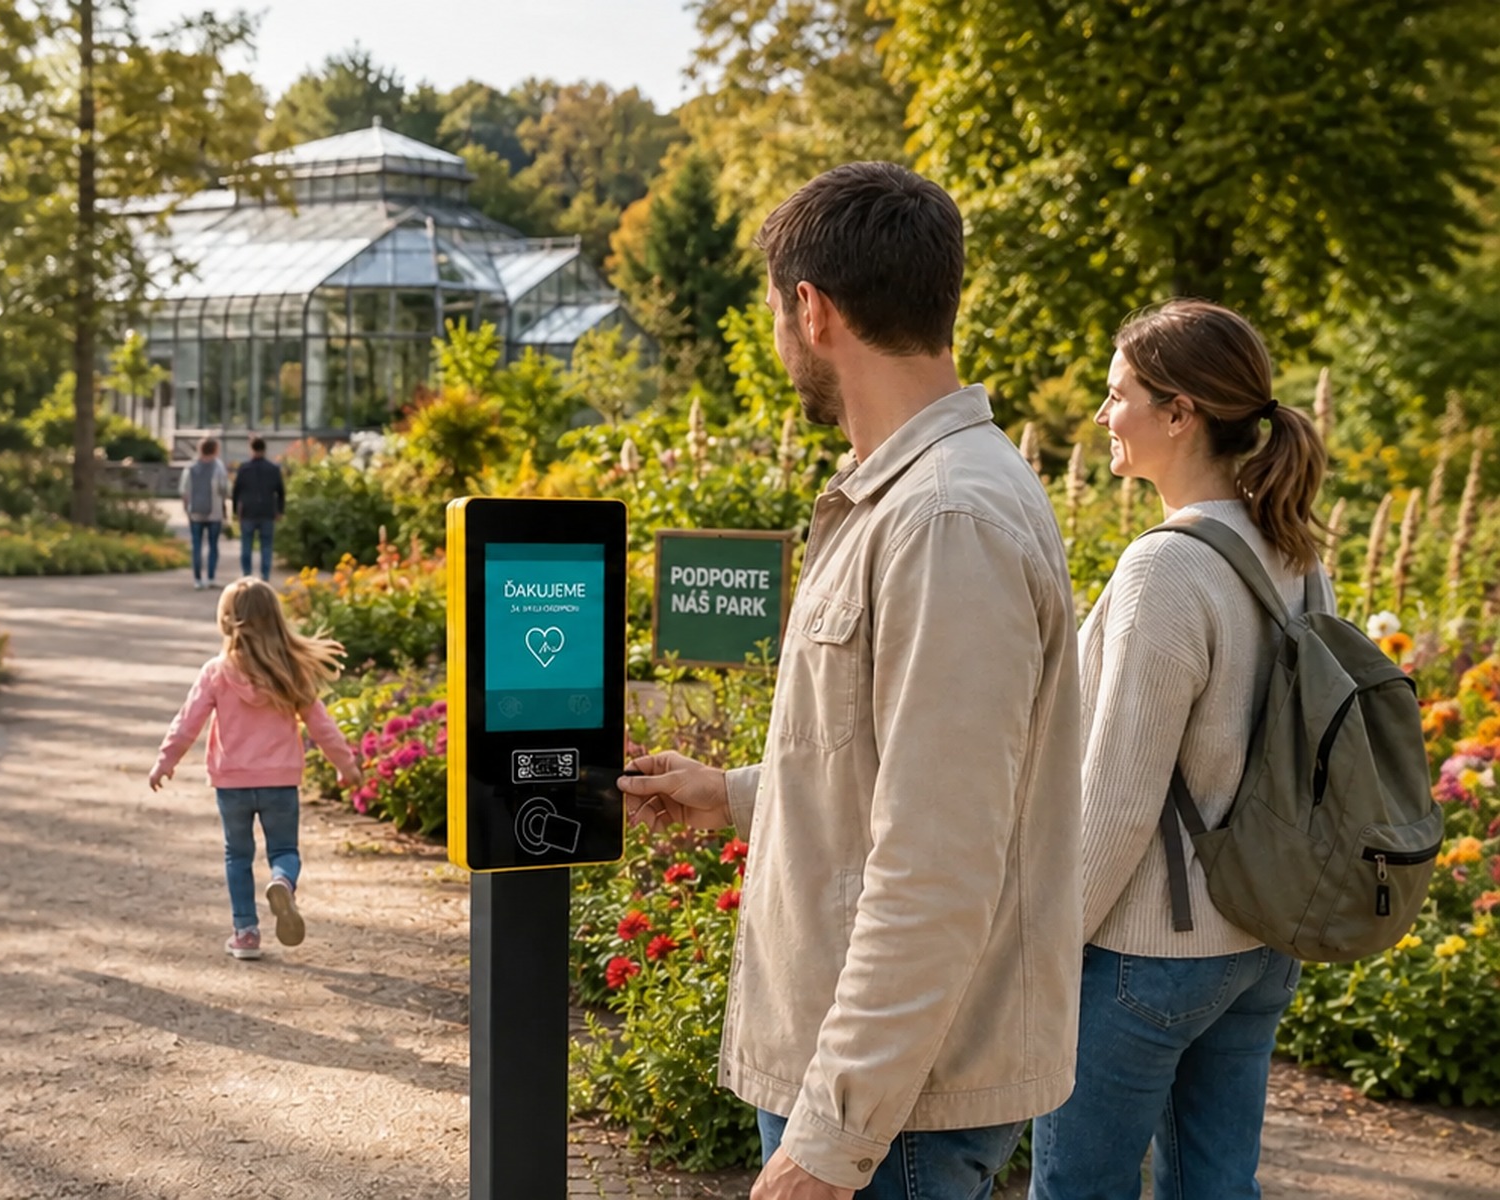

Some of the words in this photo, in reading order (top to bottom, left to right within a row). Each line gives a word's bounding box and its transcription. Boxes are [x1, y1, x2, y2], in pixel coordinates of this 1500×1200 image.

[504, 579, 586, 598] ĎAKUJEME
[670, 566, 770, 589] PODPORTE
[671, 589, 710, 614] NÁŠ
[716, 595, 766, 617] PARK
